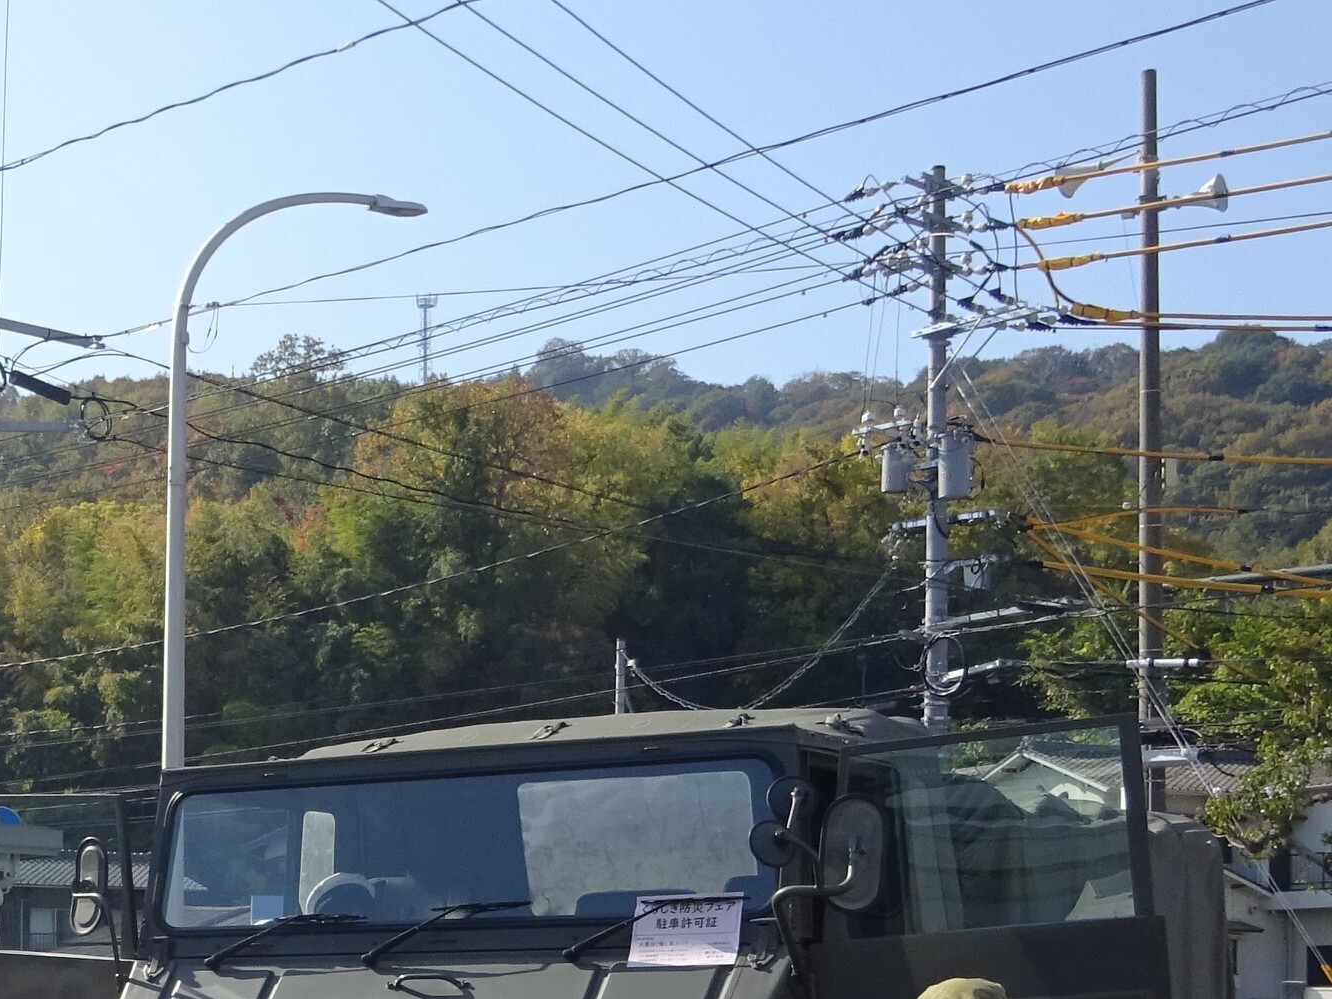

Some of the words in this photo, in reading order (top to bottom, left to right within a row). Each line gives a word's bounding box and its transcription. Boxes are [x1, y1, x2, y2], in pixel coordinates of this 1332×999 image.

[656, 917, 718, 929] 駐車許可証
